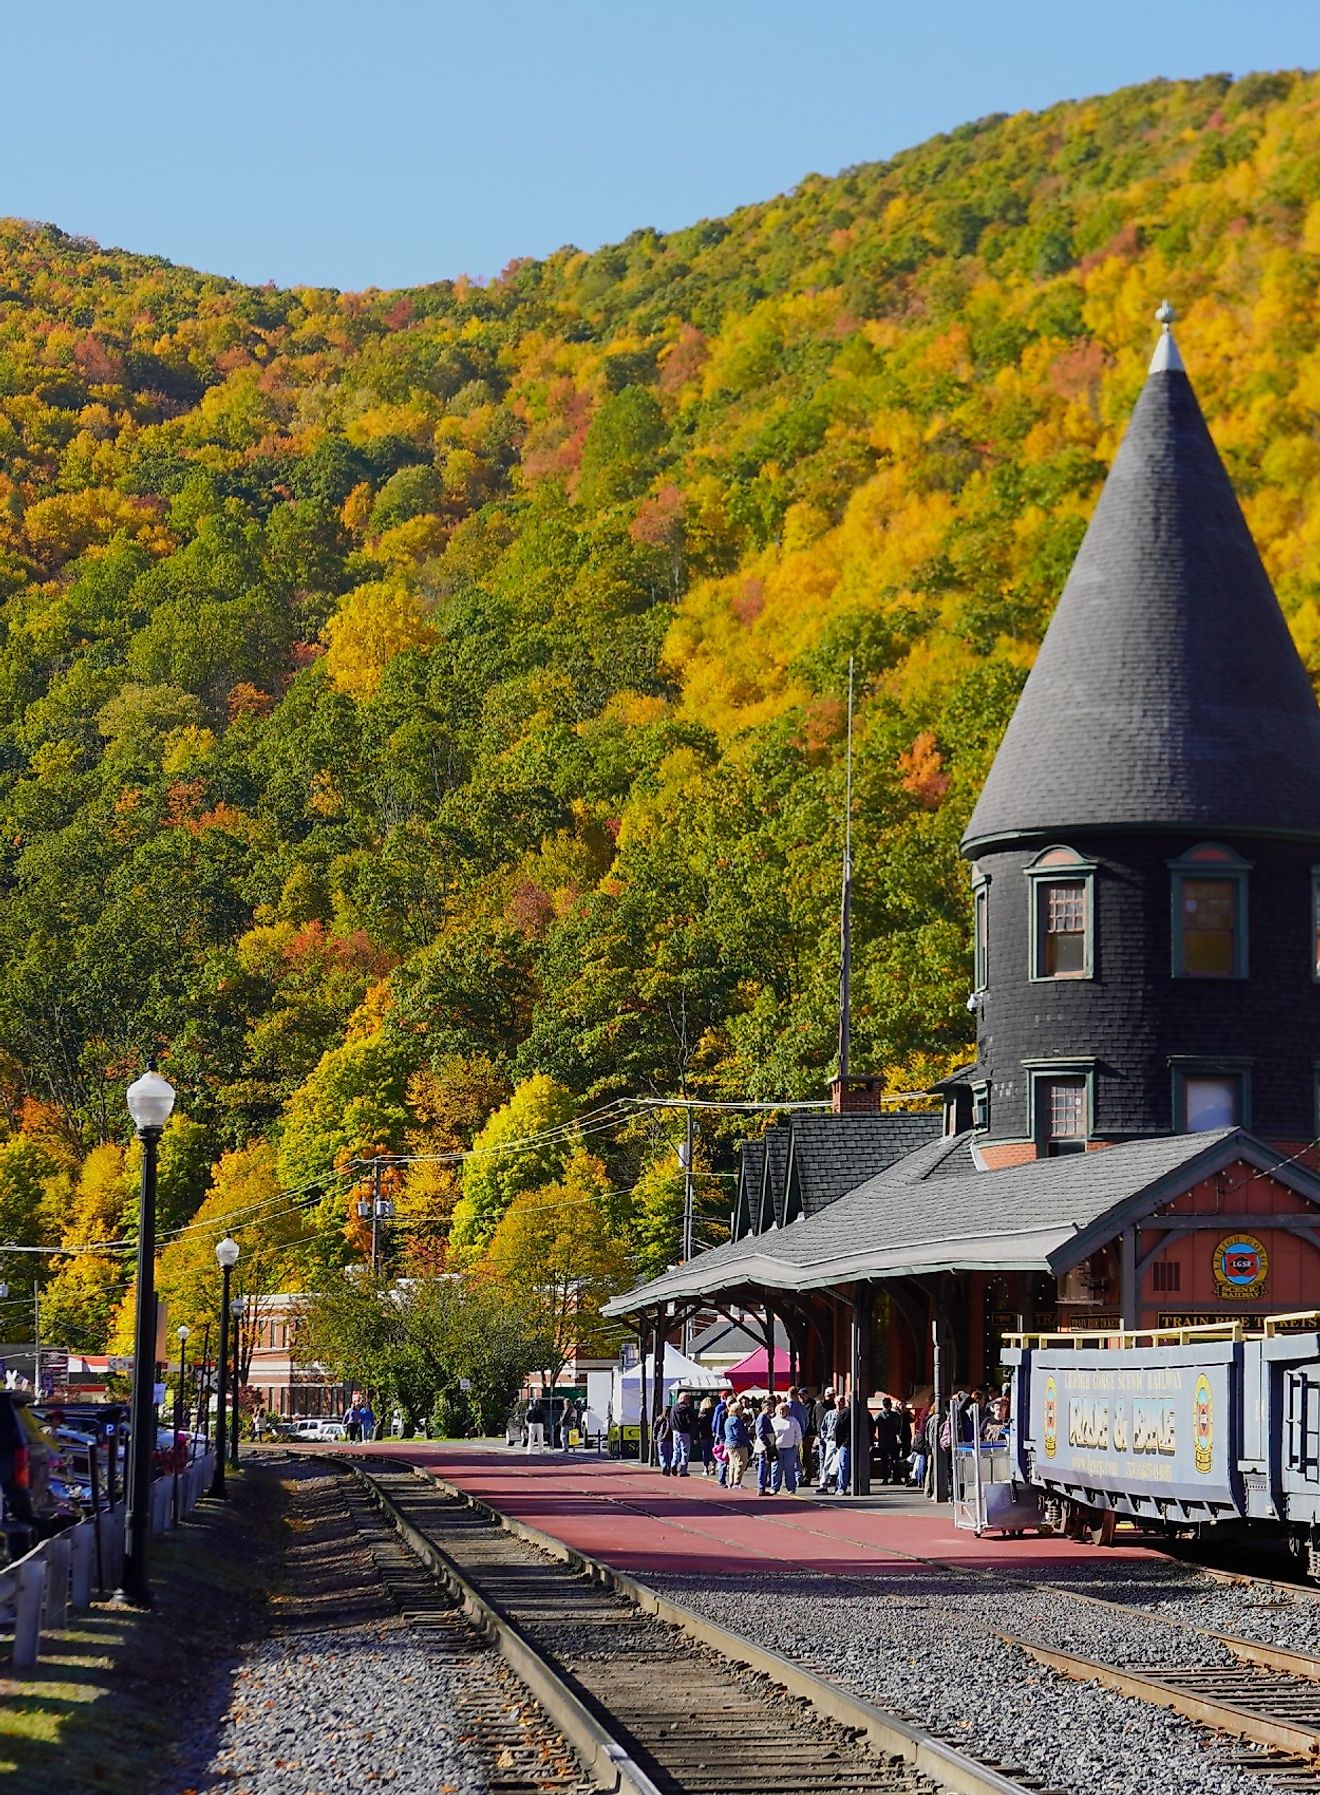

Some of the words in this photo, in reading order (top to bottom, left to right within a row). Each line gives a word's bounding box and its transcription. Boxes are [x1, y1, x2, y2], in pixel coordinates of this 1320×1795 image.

[1231, 1260, 1251, 1268] LGSR
[1221, 1285, 1260, 1293] SCENIC
[1162, 1316, 1208, 1328] TRAIN
[106, 1423, 115, 1435] P
